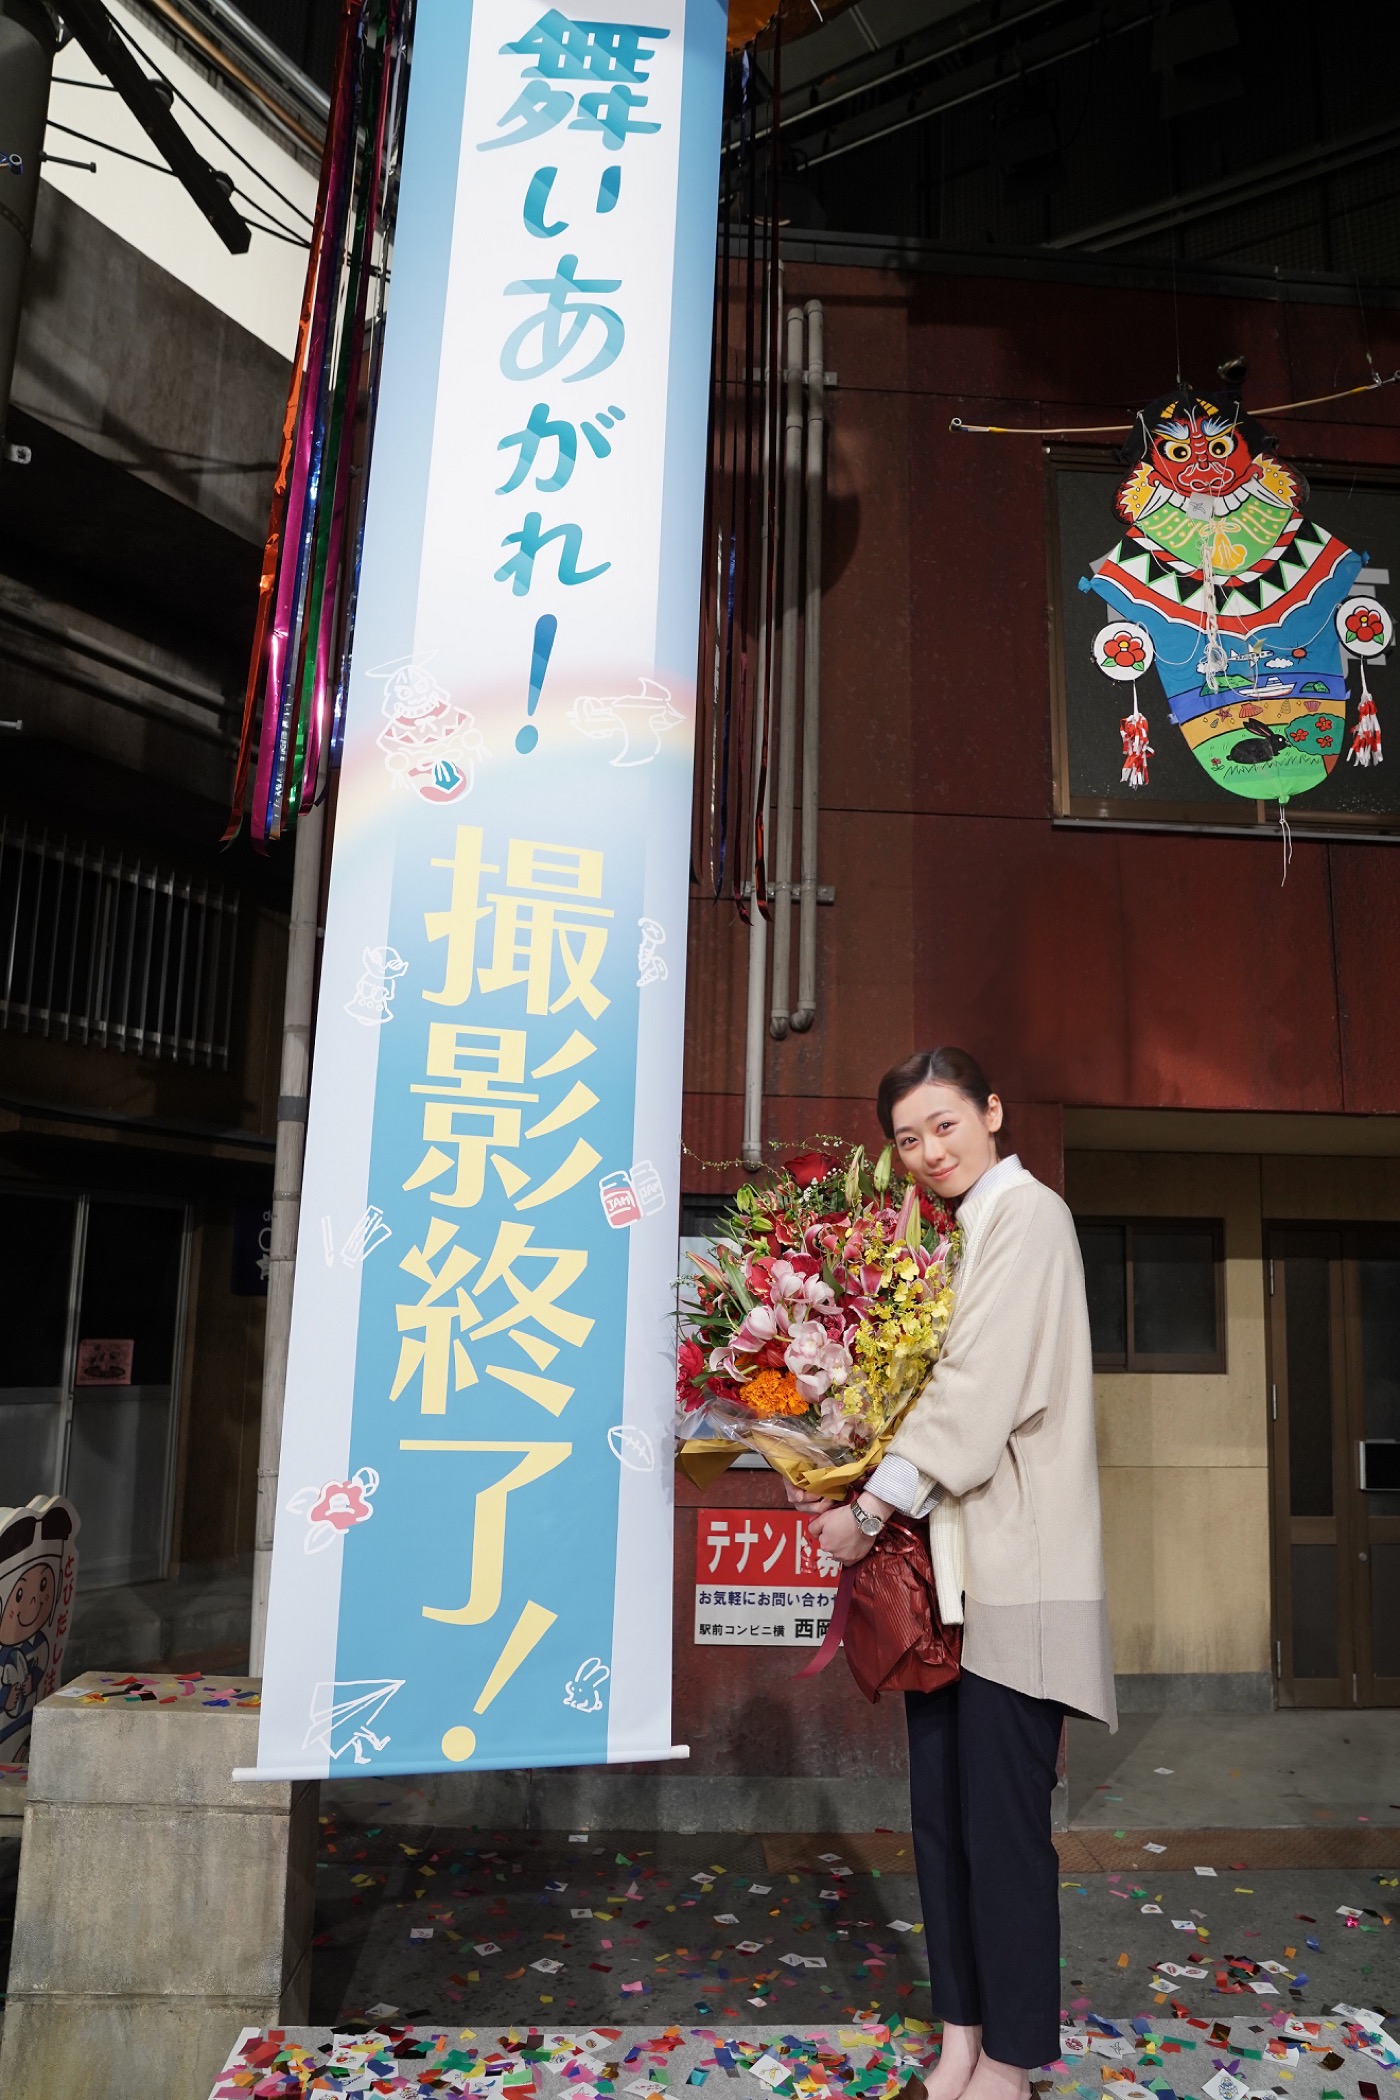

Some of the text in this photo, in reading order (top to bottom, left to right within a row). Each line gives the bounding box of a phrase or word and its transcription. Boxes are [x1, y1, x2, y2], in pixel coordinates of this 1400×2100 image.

[606, 1195, 633, 1212] JAM
[698, 1590, 837, 1608] お気軽にお問い合わ
[699, 1623, 785, 1637] 駅前コンビニ横
